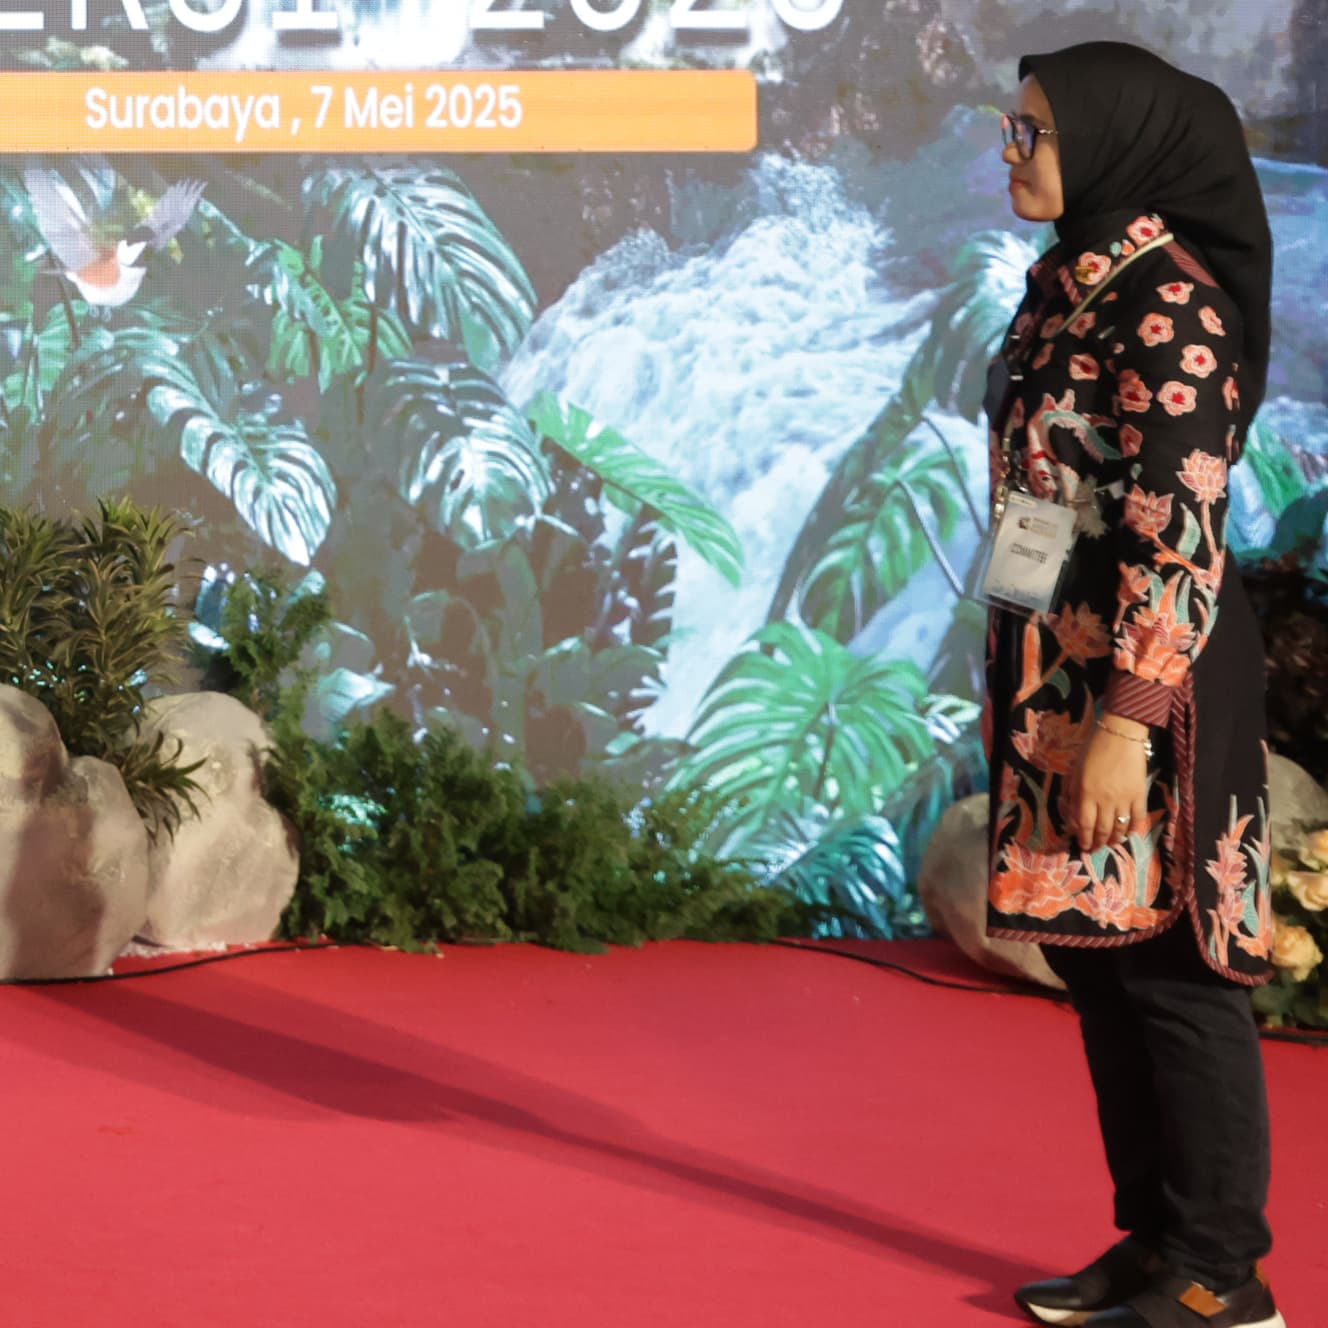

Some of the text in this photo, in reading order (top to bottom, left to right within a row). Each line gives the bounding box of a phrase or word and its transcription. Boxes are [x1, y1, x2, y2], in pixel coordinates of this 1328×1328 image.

[310, 85, 334, 128] 7
[344, 83, 414, 128] Mei
[425, 83, 523, 128] 2025
